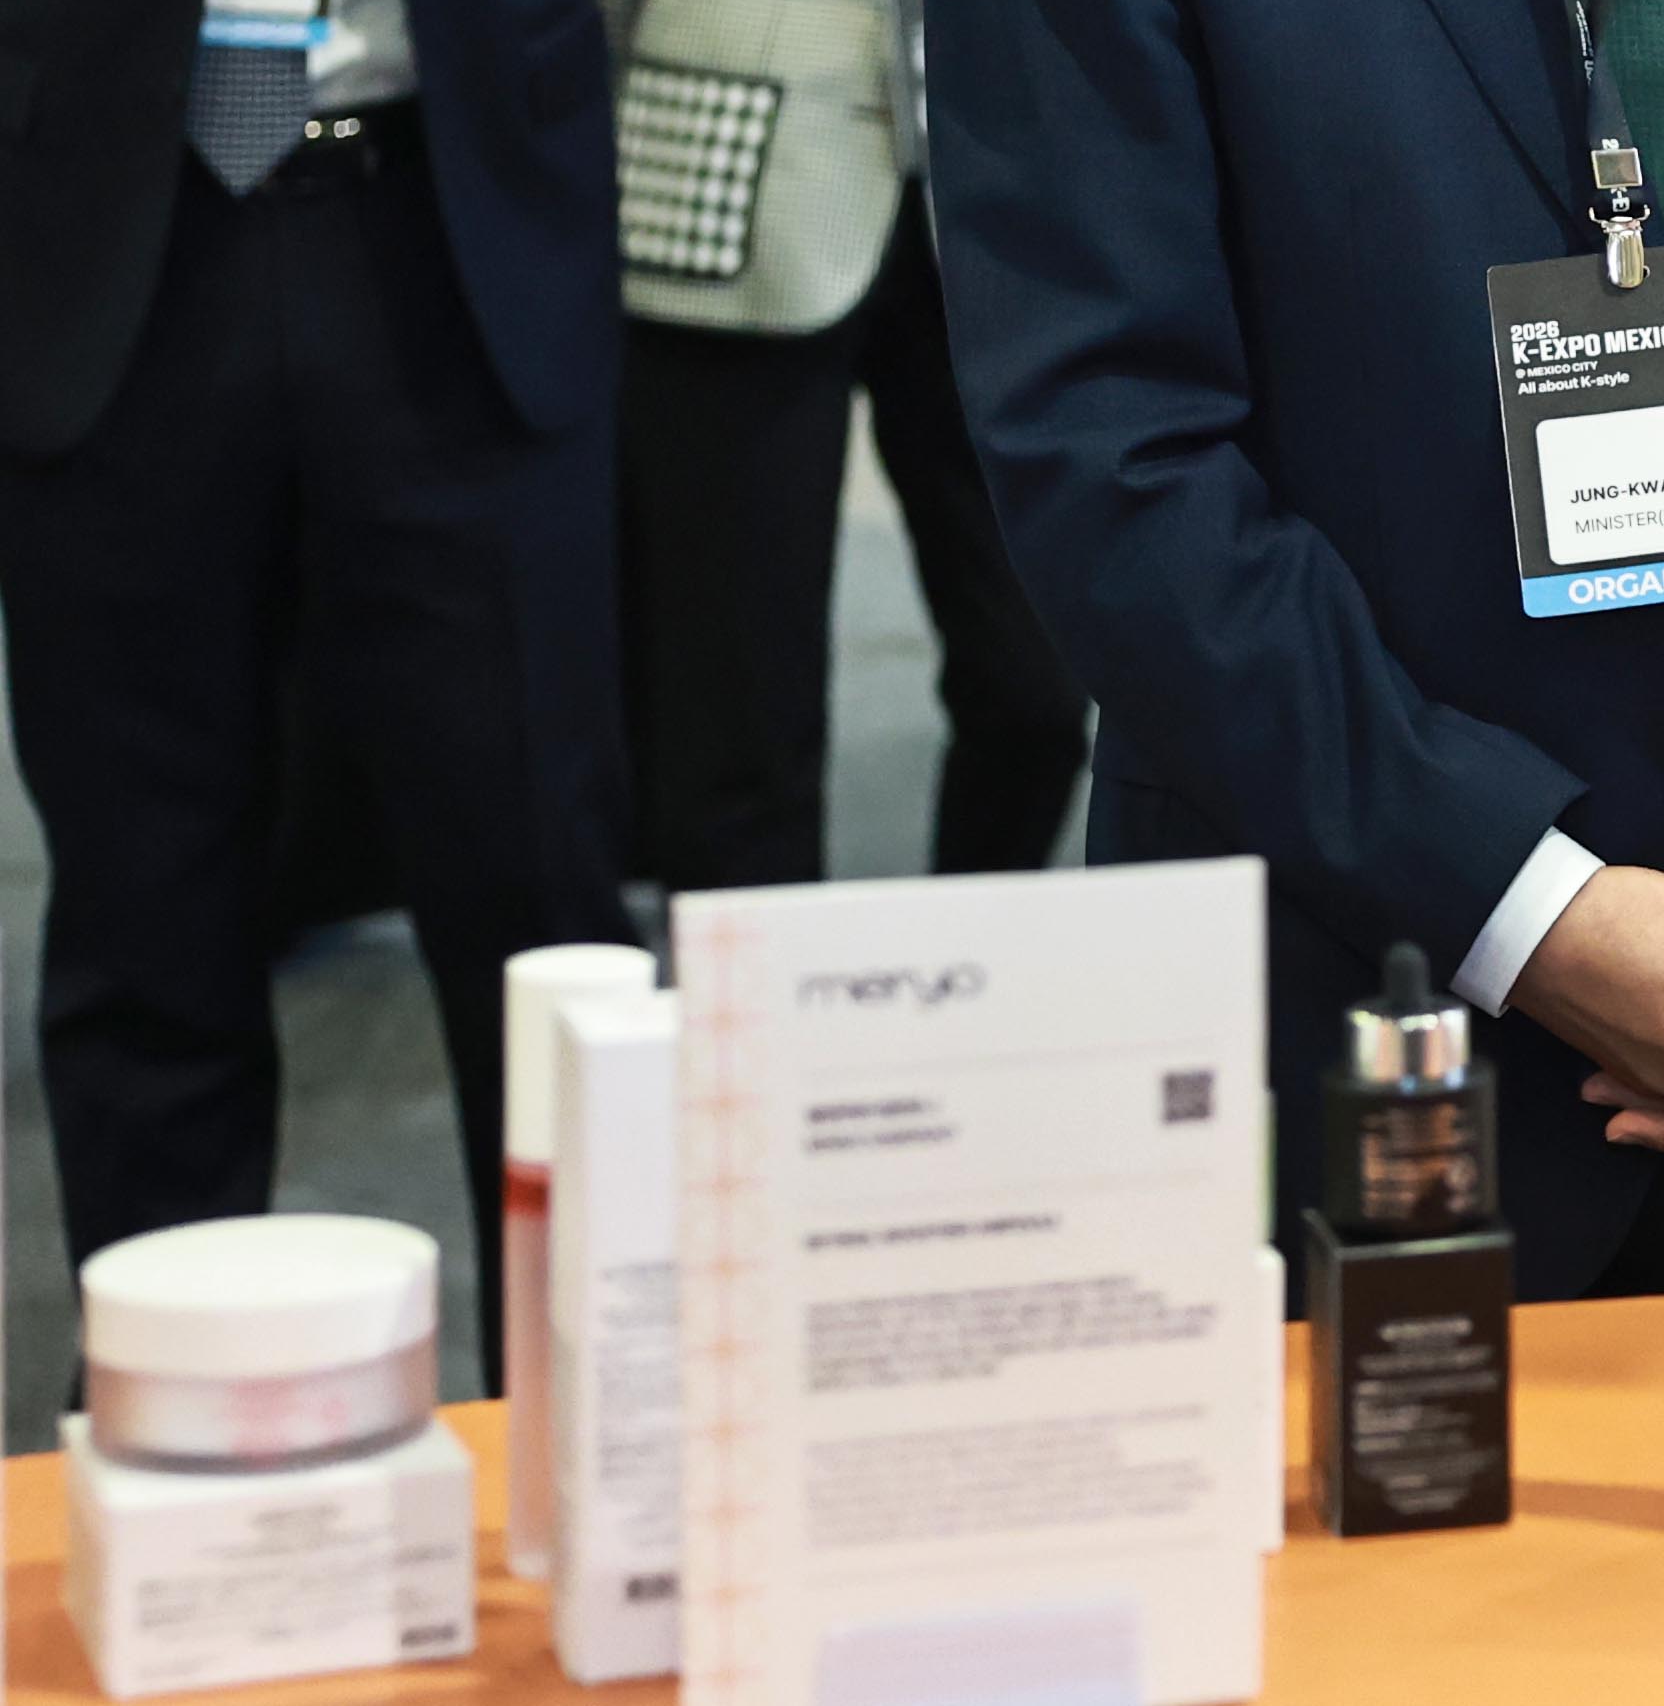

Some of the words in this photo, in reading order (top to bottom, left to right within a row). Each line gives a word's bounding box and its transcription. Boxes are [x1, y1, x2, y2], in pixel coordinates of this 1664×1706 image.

[1510, 320, 1560, 342] 2026
[1512, 333, 1601, 365] K-EXPO
[1527, 363, 1570, 377] MEXICO
[1572, 360, 1598, 372] CITY
[1517, 380, 1535, 395] All
[1536, 376, 1578, 393] about
[1580, 371, 1630, 391] K-style
